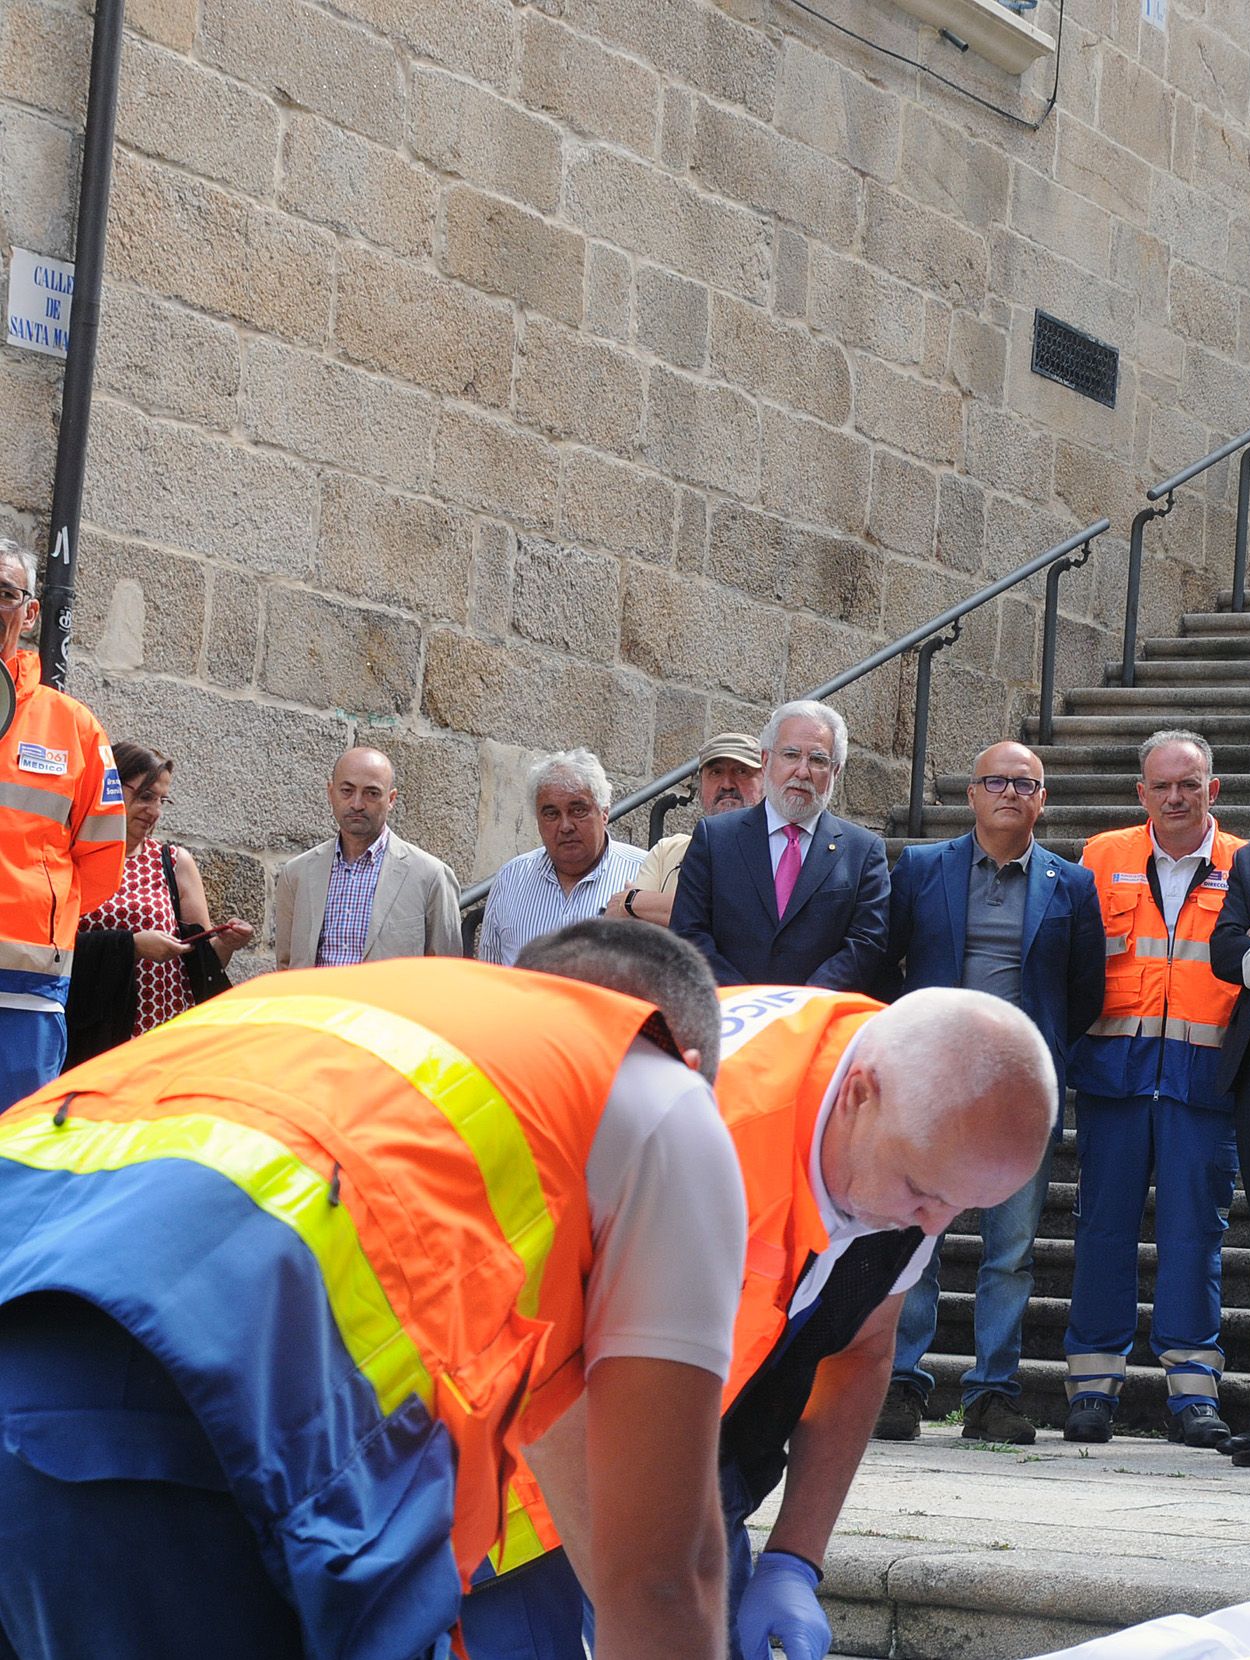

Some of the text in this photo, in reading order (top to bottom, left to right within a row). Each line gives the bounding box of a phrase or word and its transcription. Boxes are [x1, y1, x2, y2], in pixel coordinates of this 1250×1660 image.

[34, 265, 74, 295] CALLE
[45, 297, 61, 320] DE
[9, 315, 49, 345] SANTA
[47, 751, 67, 763] 061
